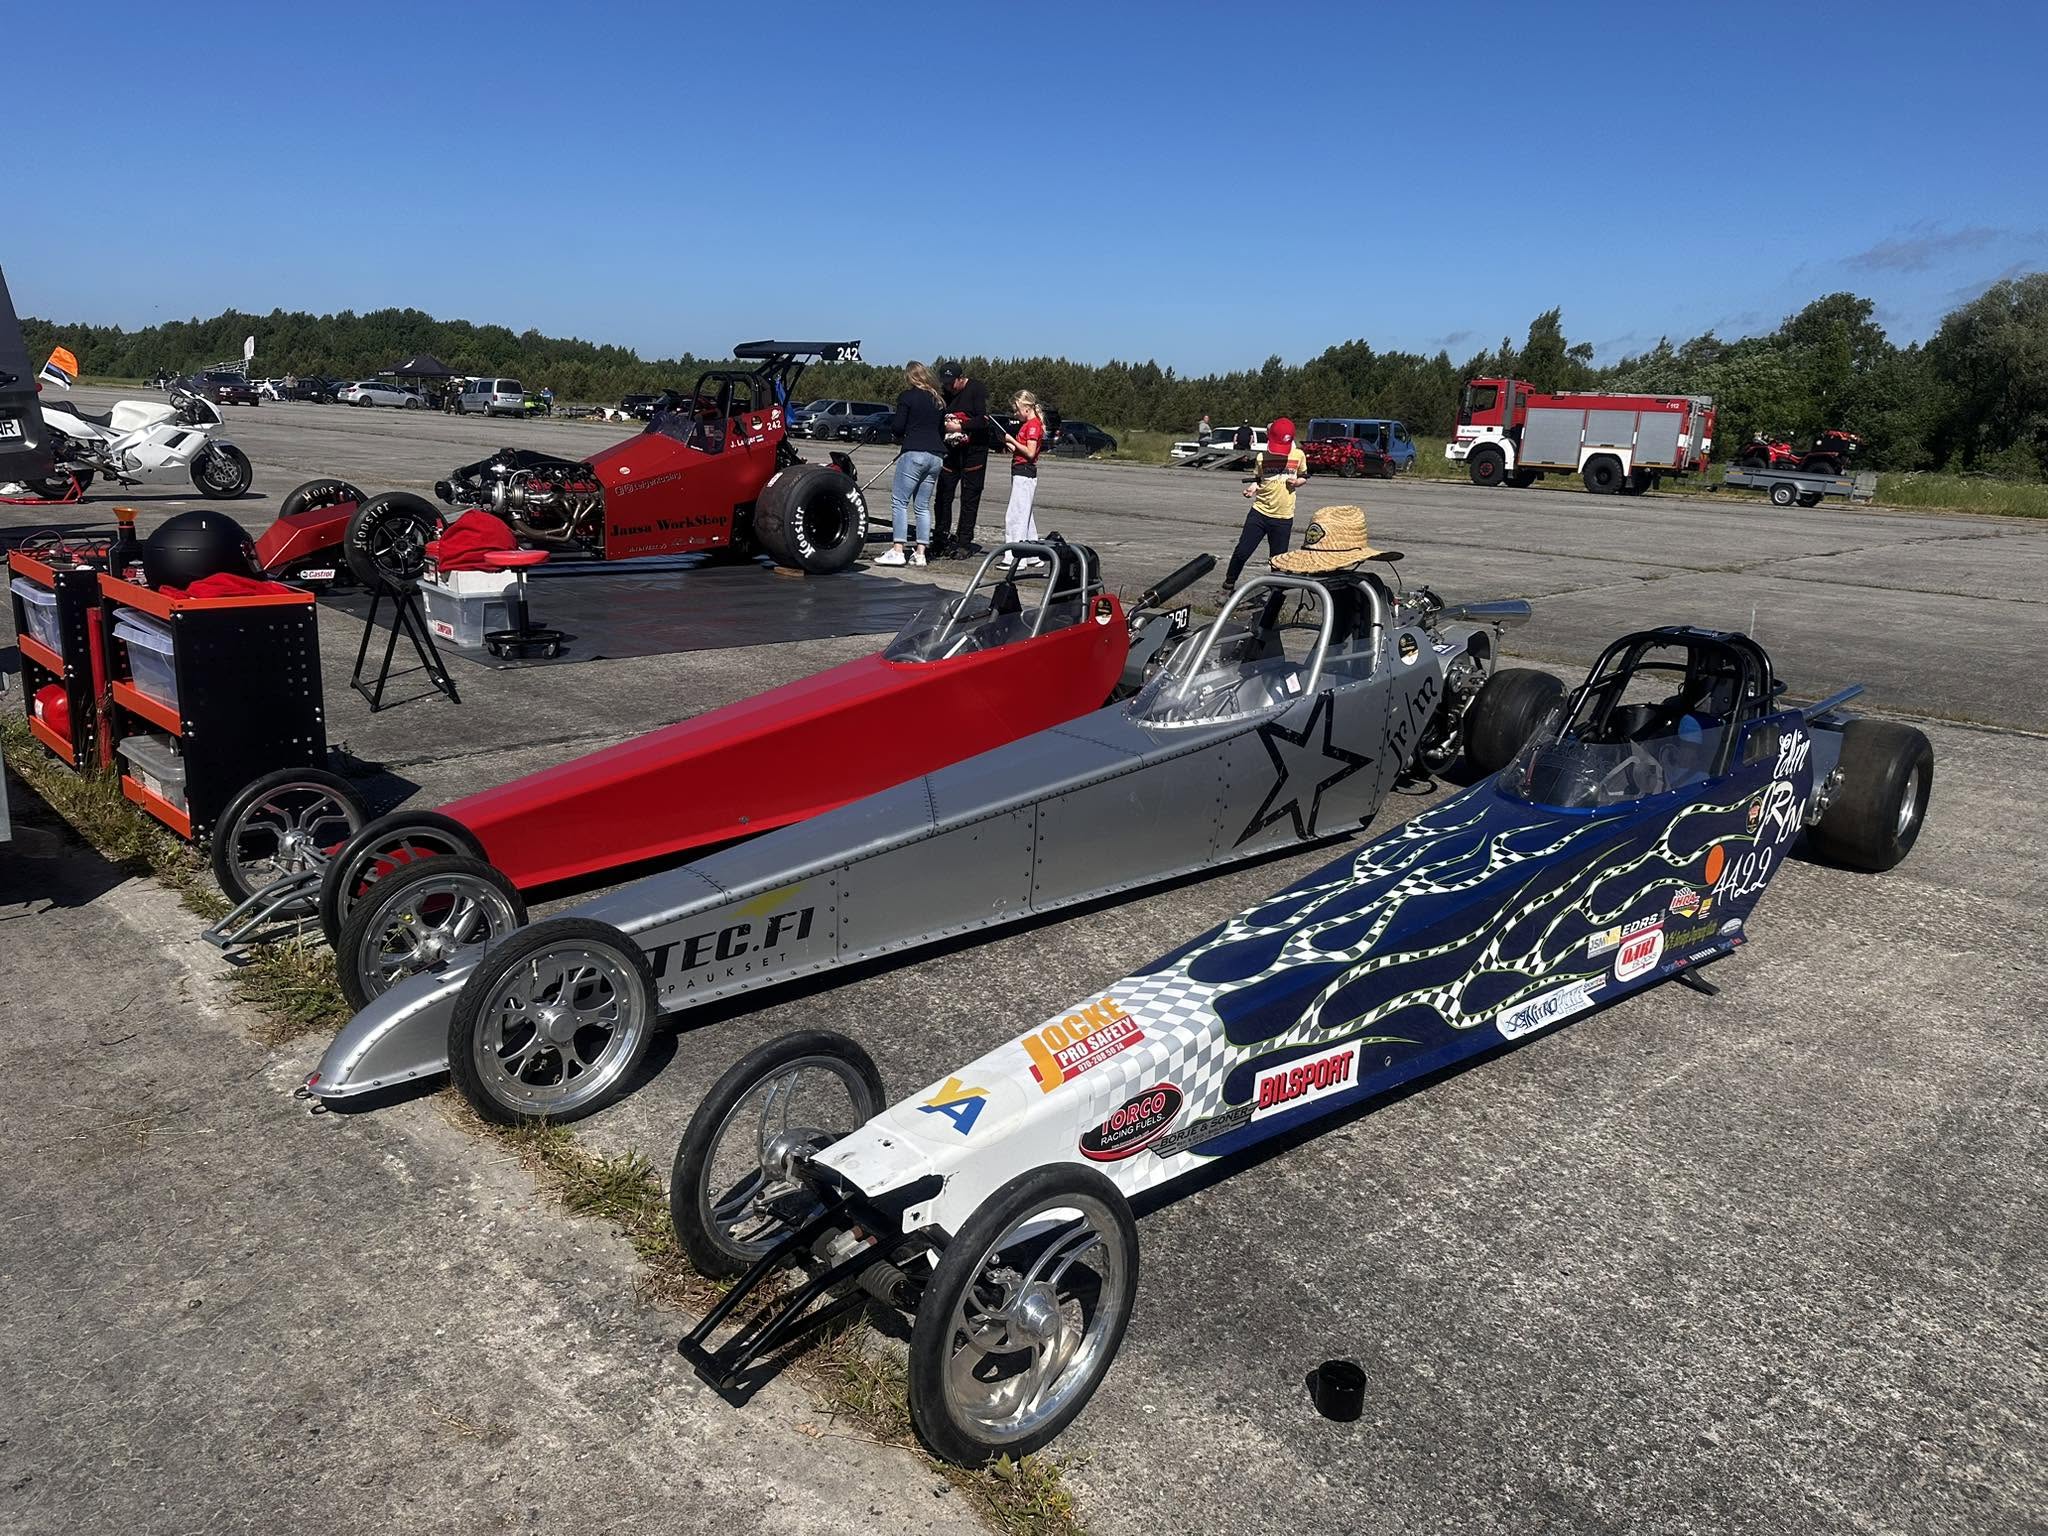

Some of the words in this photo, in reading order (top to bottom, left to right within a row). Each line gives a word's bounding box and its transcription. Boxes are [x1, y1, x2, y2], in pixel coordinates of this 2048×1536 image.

[837, 347, 859, 361] 242
[766, 420, 782, 431] 242
[307, 569, 334, 579] Castrol
[1711, 846, 1773, 906] 4422
[645, 906, 815, 980] TEC.FI
[1621, 913, 1659, 936] EDRS
[1021, 996, 1127, 1095] JOCKE
[1060, 1042, 1089, 1067] PRO
[1087, 1016, 1135, 1051] SAFETY
[1258, 1050, 1354, 1109] BILSPORT
[1100, 1125, 1134, 1147] RACING
[1135, 1113, 1163, 1131] FUELS
[1101, 1092, 1166, 1136] TORCO
[1200, 1123, 1208, 1132] &
